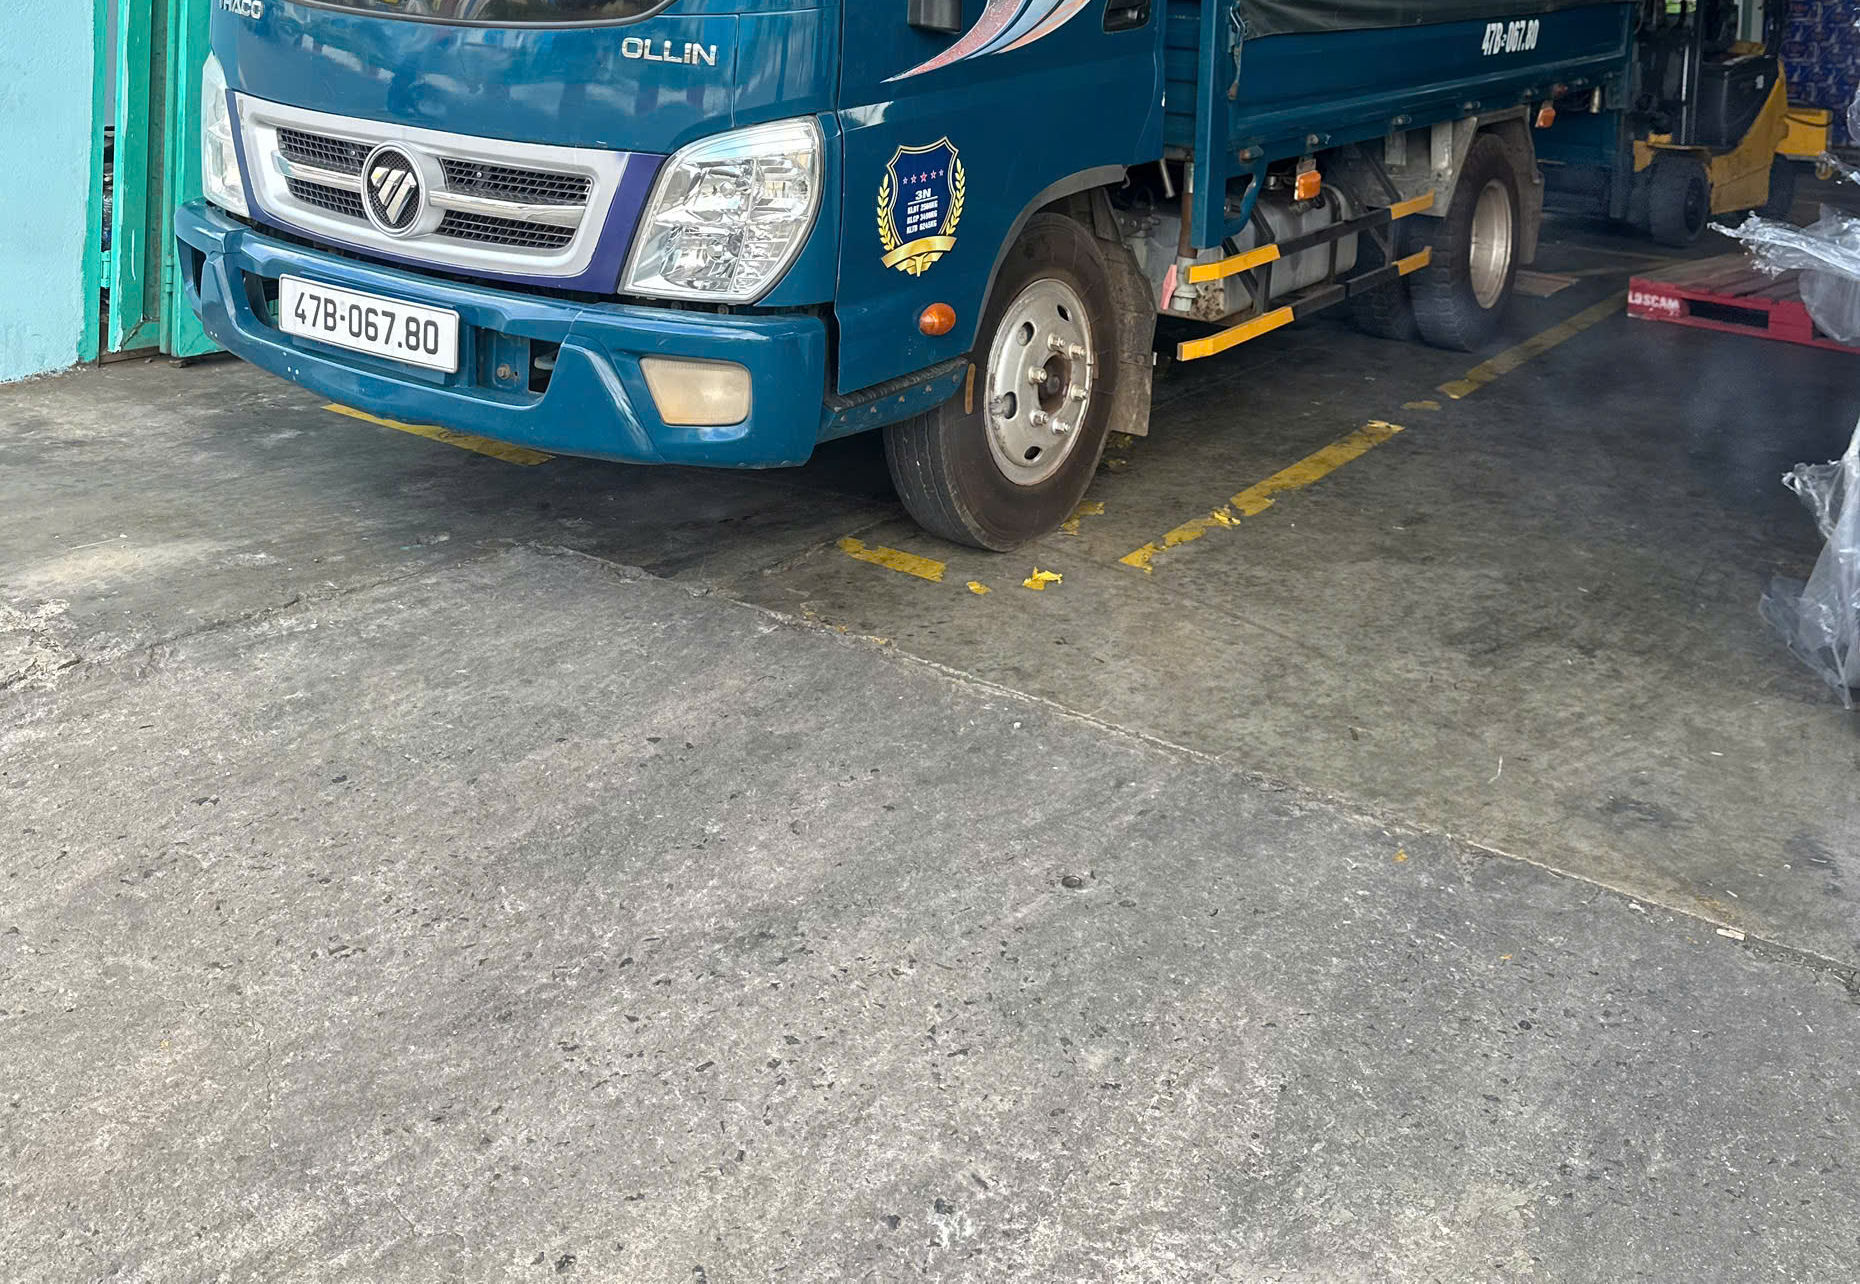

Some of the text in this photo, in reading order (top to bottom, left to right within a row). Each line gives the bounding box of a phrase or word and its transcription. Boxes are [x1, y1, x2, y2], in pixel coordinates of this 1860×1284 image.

[621, 36, 717, 66] OLLIN
[914, 187, 932, 201] 3N
[1627, 290, 1680, 310] LOSCAM
